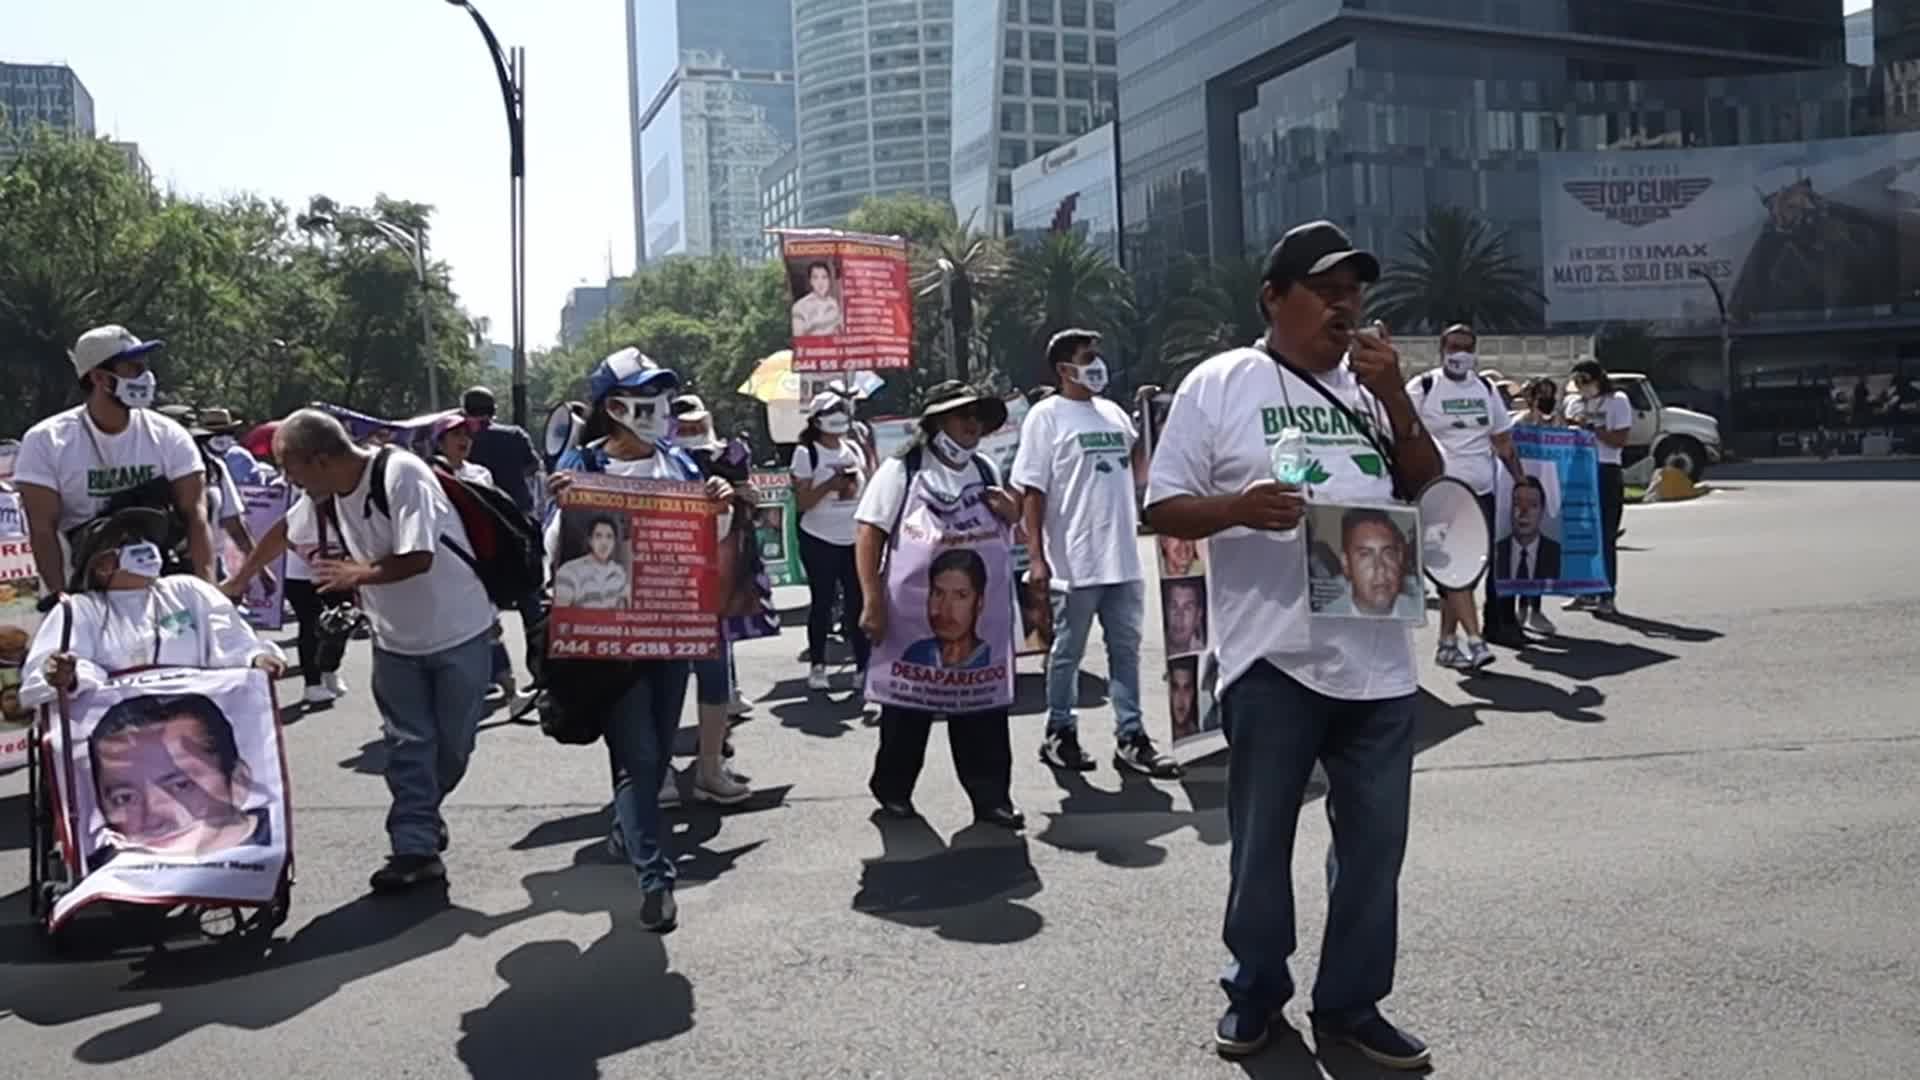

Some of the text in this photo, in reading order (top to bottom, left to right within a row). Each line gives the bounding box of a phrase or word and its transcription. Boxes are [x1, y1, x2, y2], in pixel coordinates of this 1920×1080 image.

[1600, 178, 1681, 204] TOP GUN
[1646, 244, 1708, 259] IMAX
[1553, 264, 1592, 283] MAYO
[1621, 262, 1661, 281] SOLO
[1664, 261, 1685, 281] EN
[597, 641, 621, 655] 55
[892, 662, 1006, 686] DESAPARECIDO
